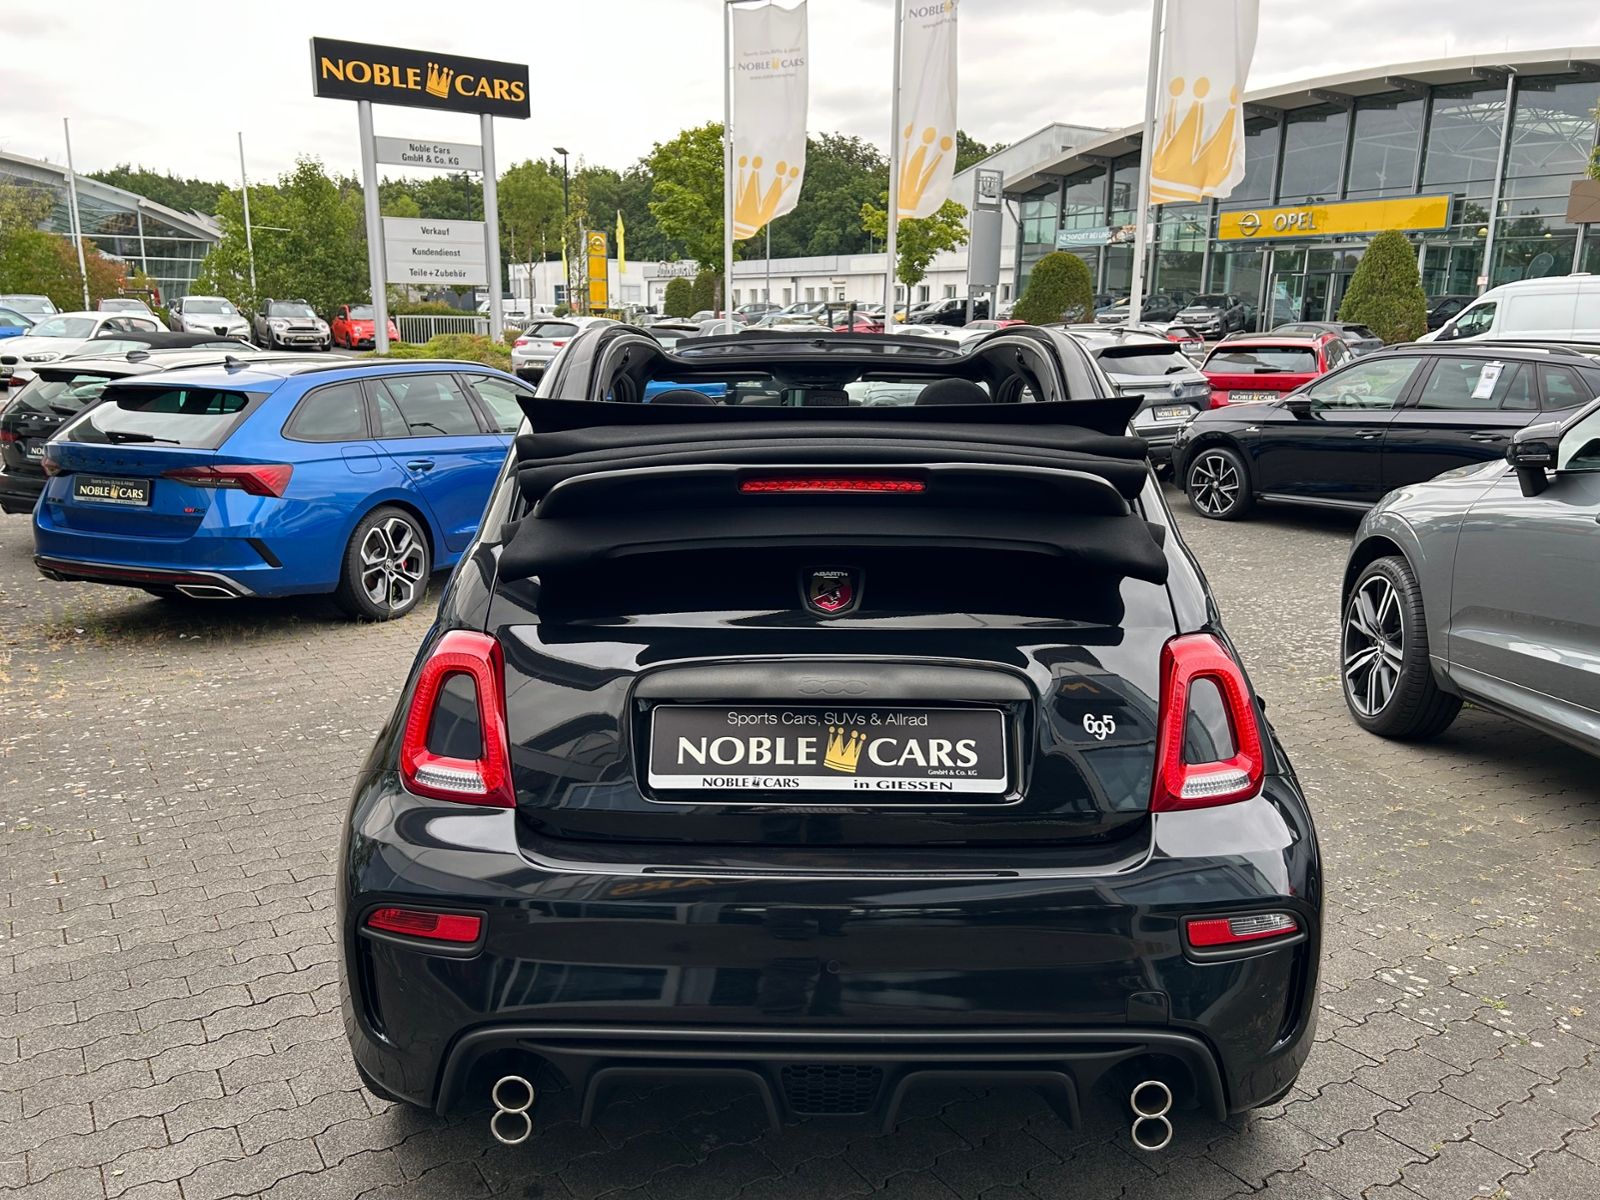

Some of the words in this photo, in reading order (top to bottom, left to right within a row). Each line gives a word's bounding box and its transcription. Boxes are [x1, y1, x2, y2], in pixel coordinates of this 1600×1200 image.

[738, 60, 770, 71] NOBLE
[781, 57, 805, 68] CARS
[321, 56, 422, 90] NOBLE
[454, 74, 526, 102] CARS
[409, 143, 431, 153] Noble
[433, 145, 451, 154] Cars
[402, 153, 424, 162] GmbH
[425, 155, 432, 163] &
[434, 156, 447, 164] Co.
[448, 157, 460, 165] KG
[1273, 211, 1317, 232] OPEL
[421, 226, 450, 236] Verkauf
[412, 247, 461, 256] Kundendienst
[79, 485, 110, 497] NOBLE
[119, 487, 144, 499] CARS
[727, 711, 778, 727] Sports
[781, 711, 821, 727] Cars,
[823, 711, 866, 726] SUVs
[869, 713, 882, 726] &
[885, 712, 928, 726] Allrad
[1083, 713, 1116, 740] 695
[677, 736, 817, 765] NOBLE
[868, 737, 979, 768] CARS
[702, 777, 749, 788] NOBLE
[763, 777, 800, 788] CARS
[853, 779, 870, 789] in
[876, 780, 953, 791] GIESSEN
